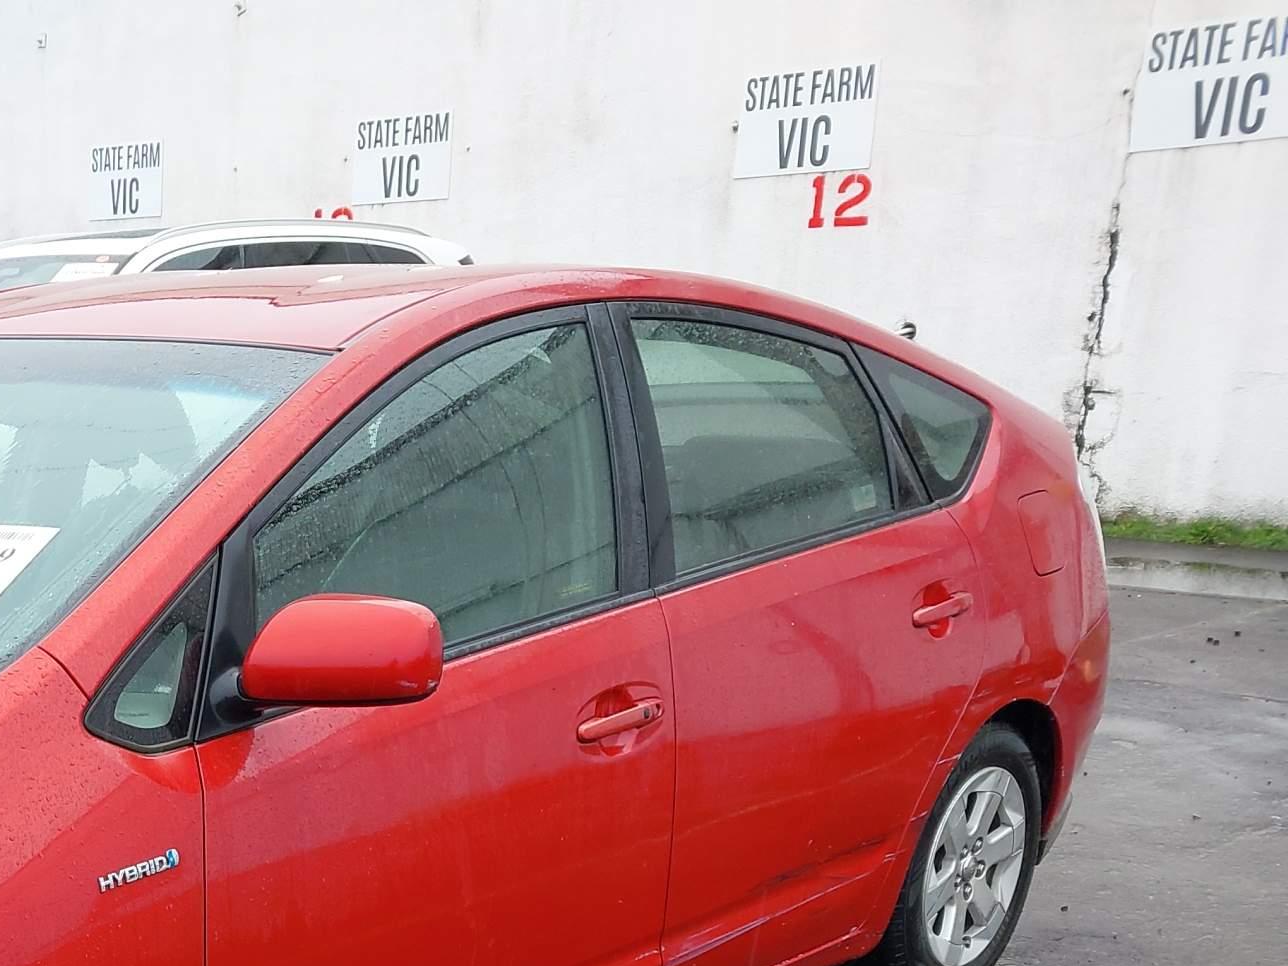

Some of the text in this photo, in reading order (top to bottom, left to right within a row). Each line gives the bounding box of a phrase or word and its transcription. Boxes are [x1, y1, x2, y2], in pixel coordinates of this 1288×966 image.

[1148, 22, 1237, 73] STATE
[745, 64, 875, 112] STATE FARM
[1194, 72, 1270, 140] VIC
[357, 112, 450, 150] STATE FARM
[778, 114, 832, 170] VIC
[91, 142, 161, 173] STATE FARM
[382, 154, 420, 199] VIC
[110, 177, 140, 216] VIC
[807, 172, 873, 230] 12
[98, 855, 171, 893] HYBRID
